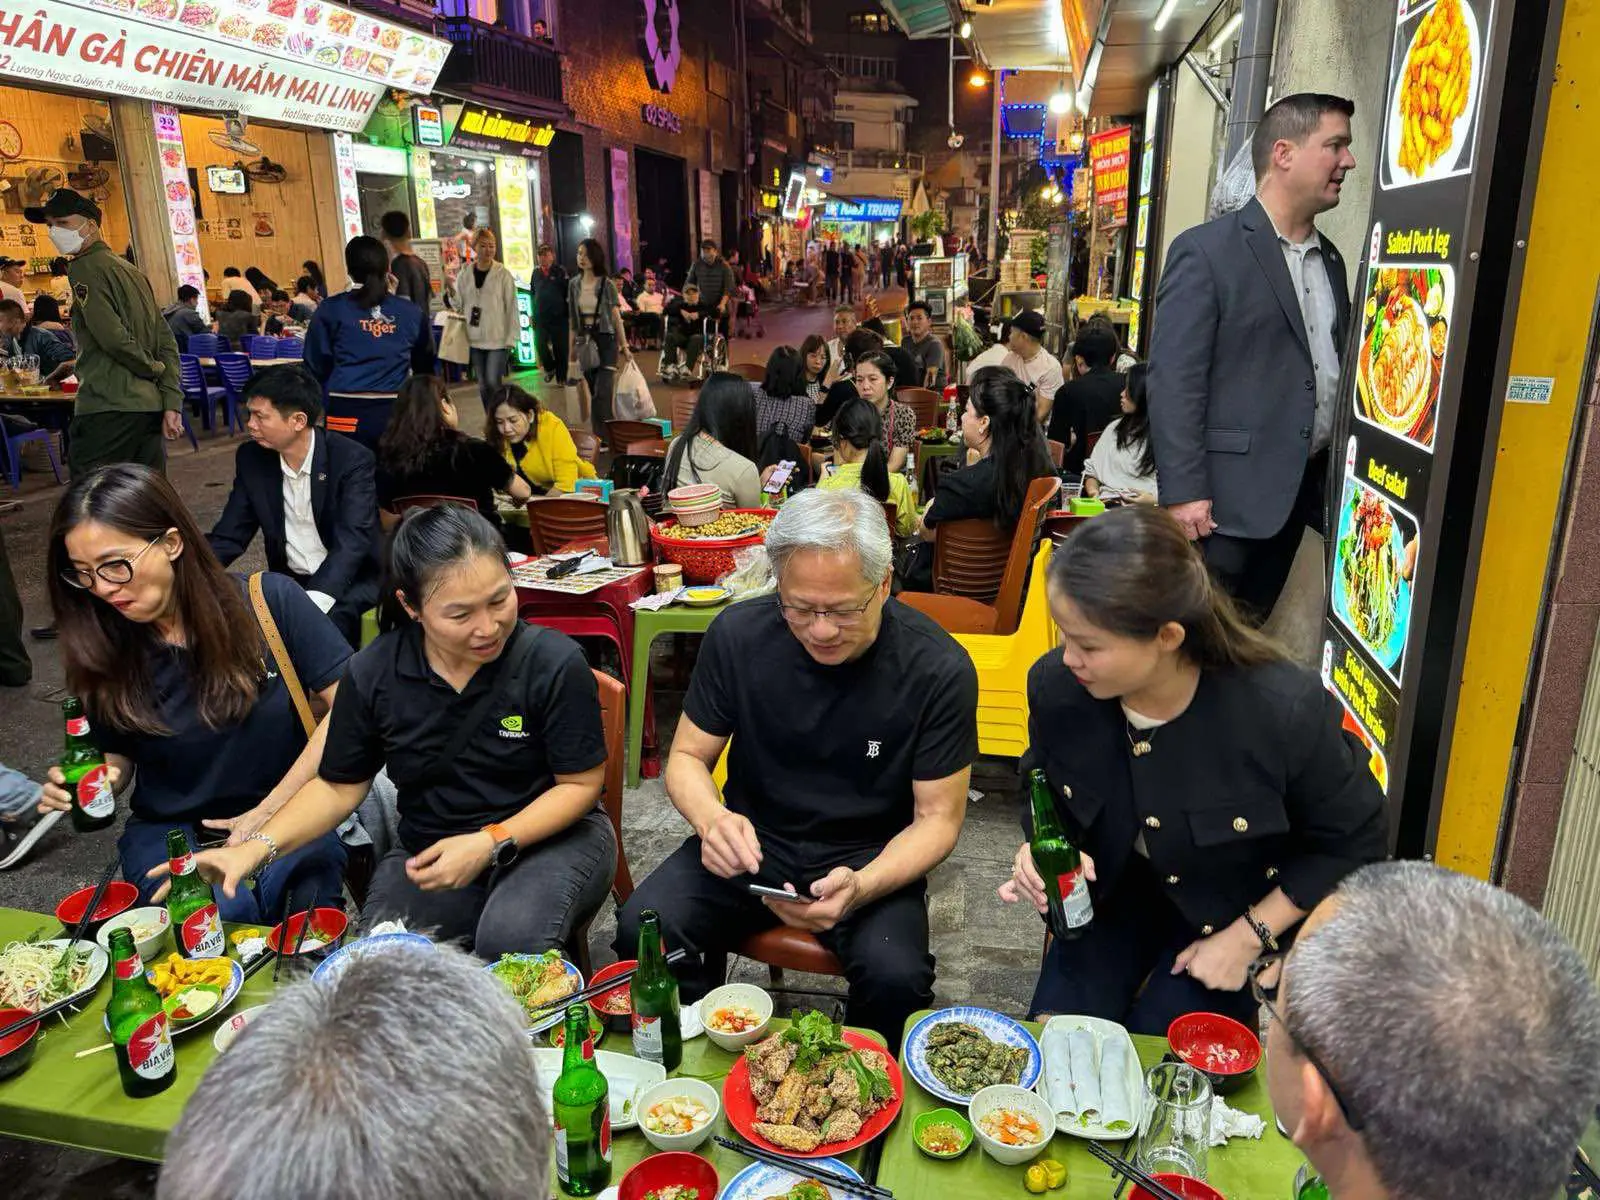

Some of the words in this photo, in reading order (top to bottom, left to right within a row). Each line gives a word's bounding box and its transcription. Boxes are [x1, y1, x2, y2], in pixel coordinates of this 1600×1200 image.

[0, 54, 11, 69] 2
[80, 28, 127, 68] GÀ
[134, 44, 225, 86] CHIÊN
[222, 62, 287, 98] MẮM
[284, 77, 330, 105] MAI
[327, 85, 376, 114] LINH
[282, 106, 314, 121] Hotline:
[867, 202, 900, 217] TRUNG
[1386, 229, 1413, 255] Salted
[1412, 227, 1434, 254] Pork
[1433, 227, 1451, 260] leg
[359, 319, 397, 338] Tiger
[1367, 457, 1387, 487] Beef
[1385, 471, 1408, 500] salad
[1345, 649, 1365, 687] Fried
[1363, 677, 1379, 709] egg
[1334, 665, 1350, 696] with
[1364, 702, 1386, 747] brain
[195, 941, 211, 952] BIA
[142, 1055, 161, 1070] BIA
